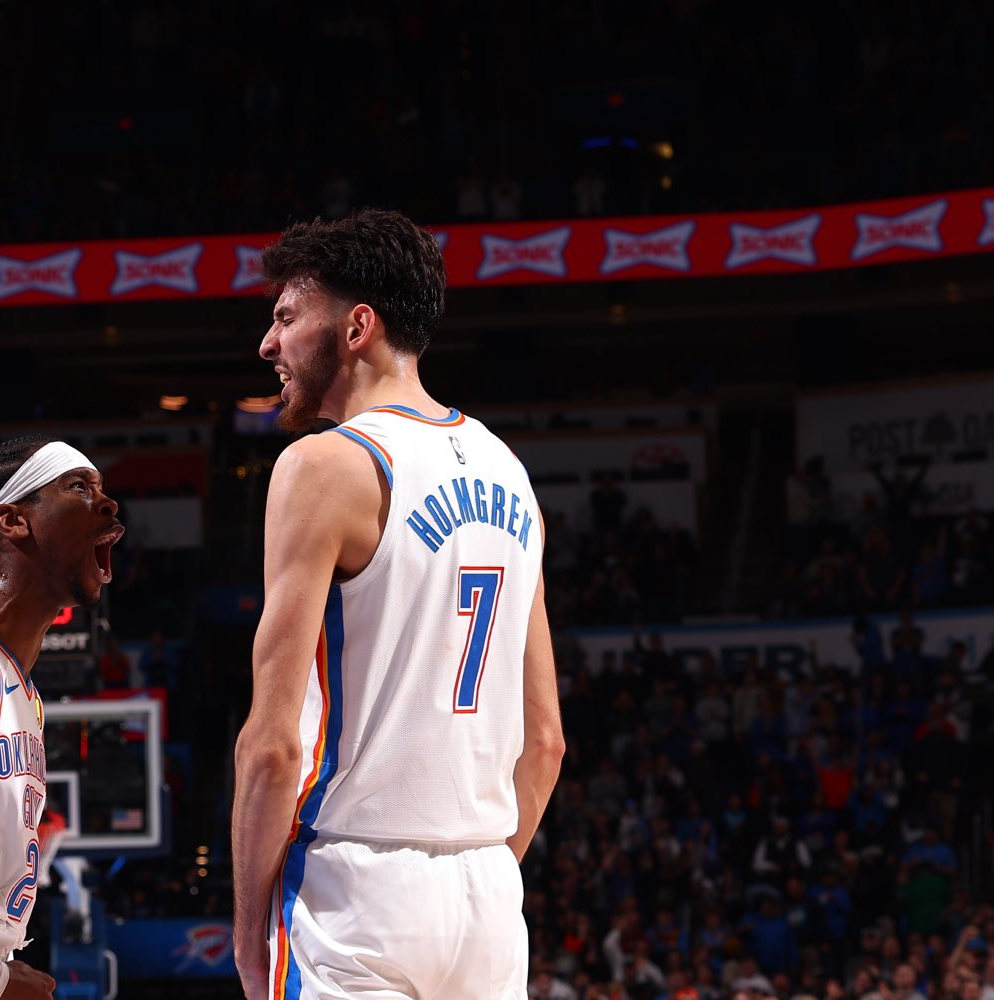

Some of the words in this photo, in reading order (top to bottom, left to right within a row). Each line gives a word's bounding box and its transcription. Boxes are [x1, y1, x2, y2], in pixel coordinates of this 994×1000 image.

[963, 411, 994, 449] OA
[406, 477, 532, 553] HOLMGREN
[453, 566, 505, 713] 7
[6, 838, 40, 922] 2
